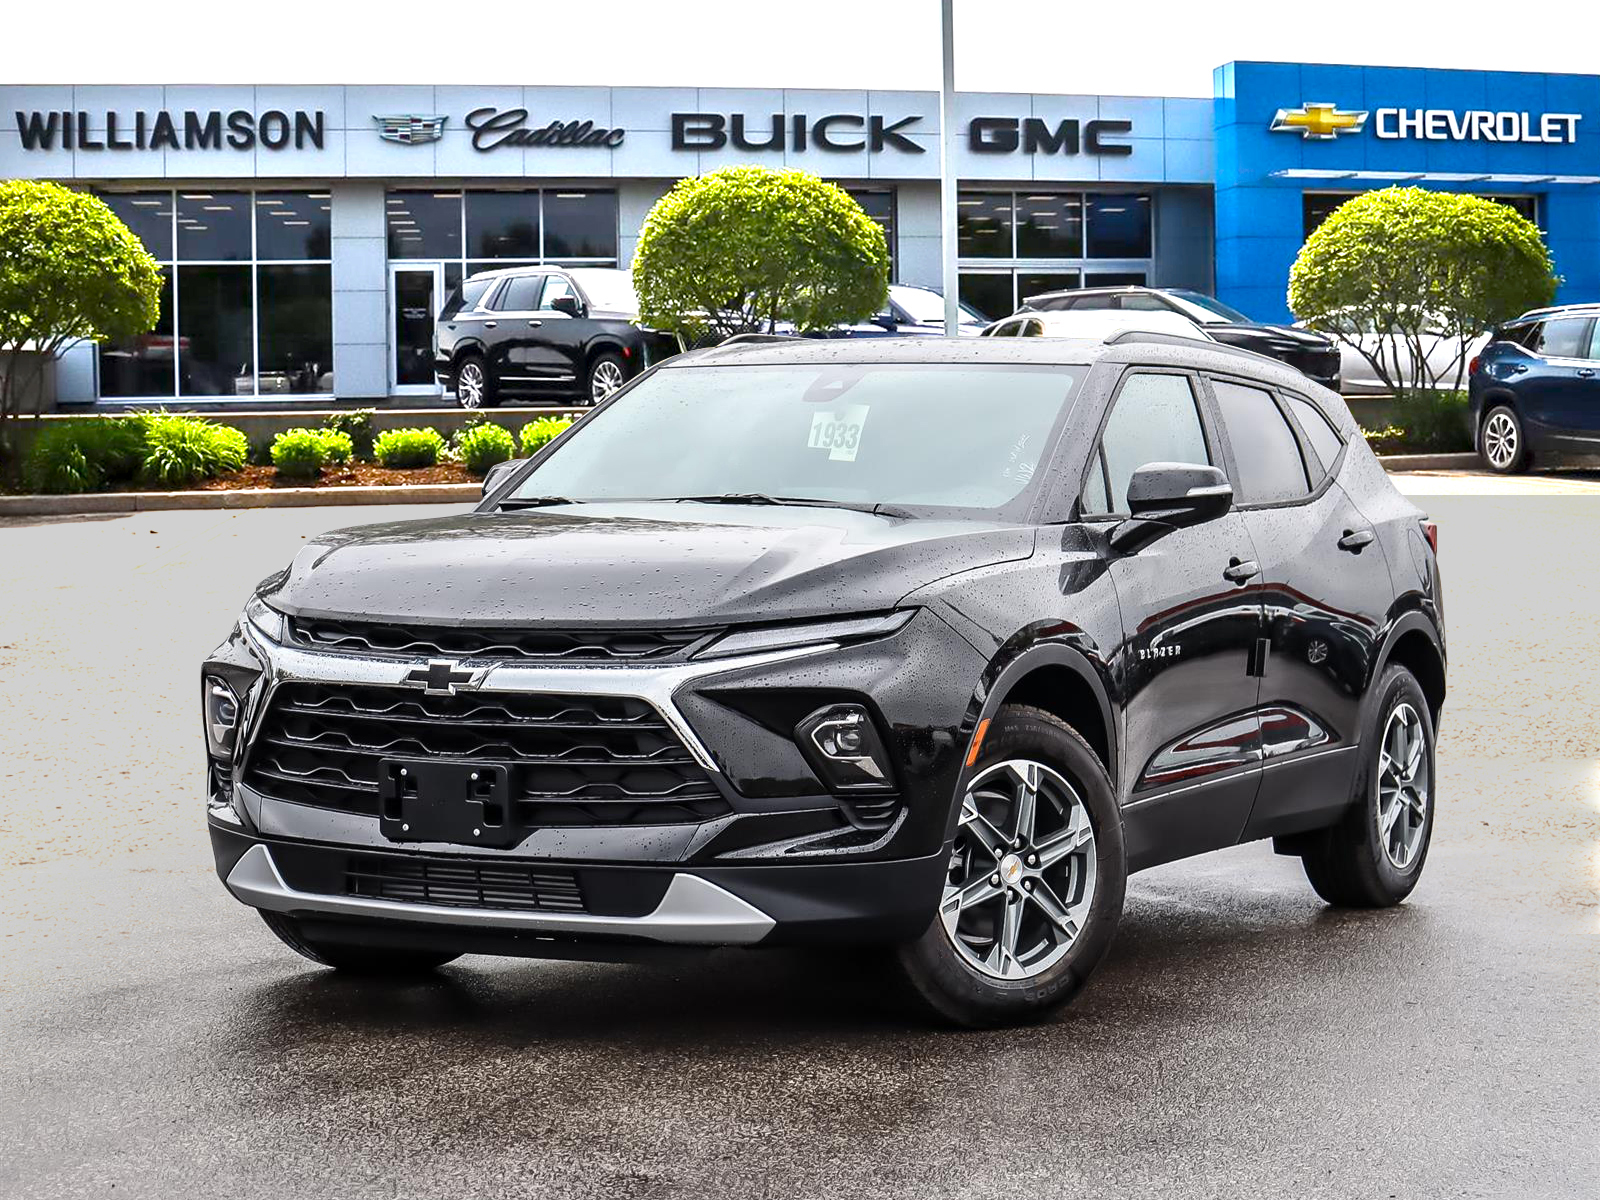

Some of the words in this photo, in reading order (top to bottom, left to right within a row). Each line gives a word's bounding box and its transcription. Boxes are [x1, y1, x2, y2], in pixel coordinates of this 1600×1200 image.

[16, 110, 324, 151] WILLIAMSON
[465, 108, 625, 152] Cadillac
[672, 113, 925, 153] BUICK
[969, 117, 1132, 155] GMC
[1376, 107, 1581, 143] CHEVROLET
[813, 421, 860, 449] 1933
[1139, 645, 1181, 660] BLAZER
